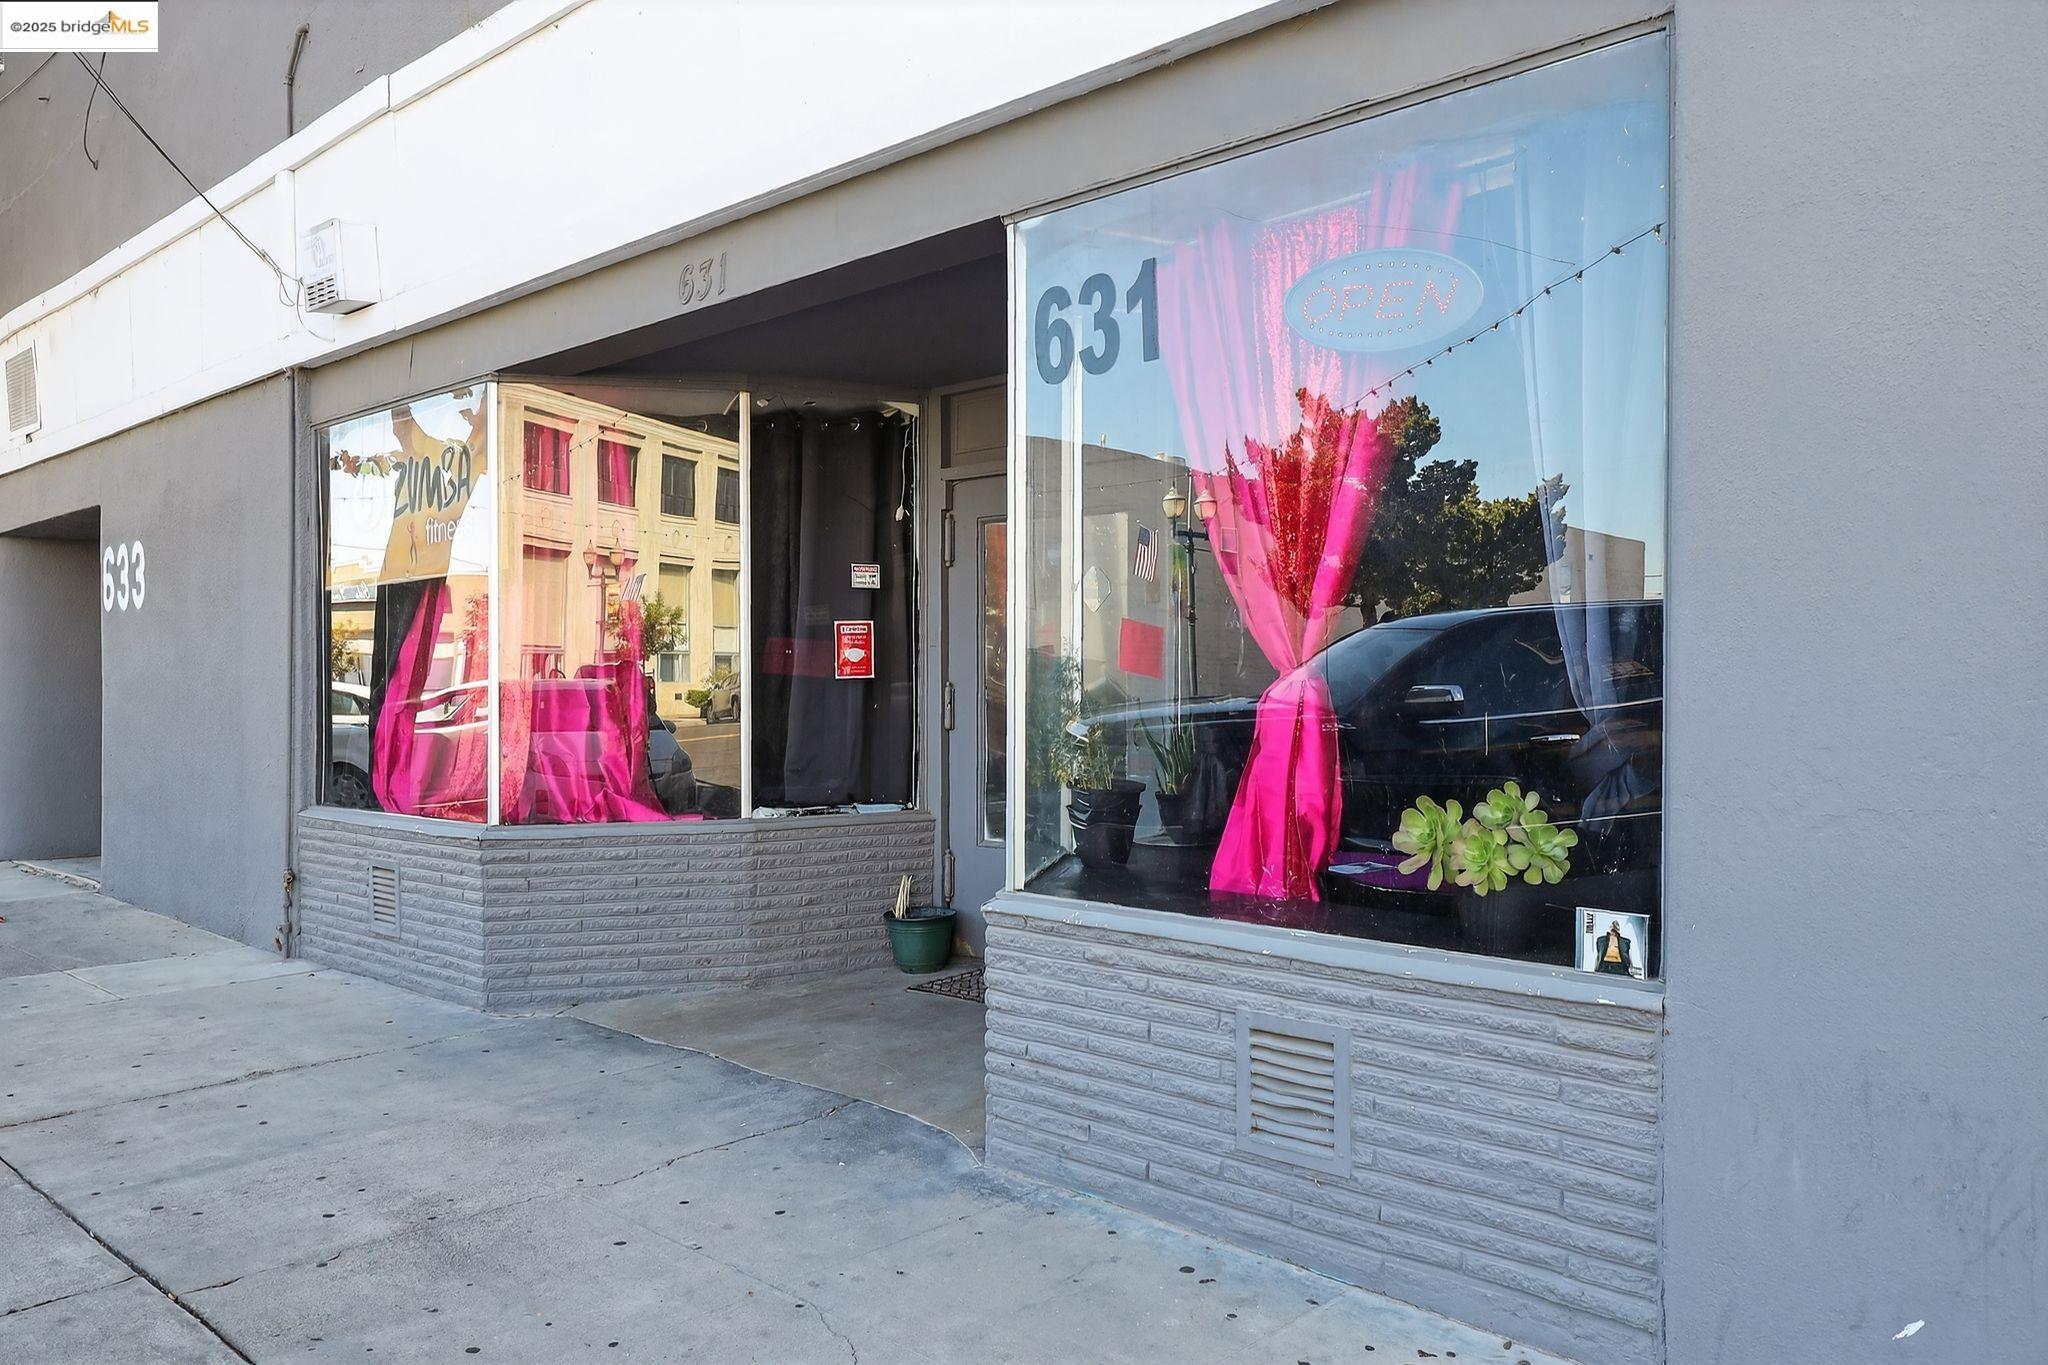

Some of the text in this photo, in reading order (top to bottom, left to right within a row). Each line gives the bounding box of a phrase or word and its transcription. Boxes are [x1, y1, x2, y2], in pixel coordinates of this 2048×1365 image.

[678, 251, 728, 306] 631
[1303, 277, 1460, 324] OPEN
[1034, 257, 1160, 385] 631
[392, 444, 472, 519] ZUMBA
[102, 540, 146, 613] 633
